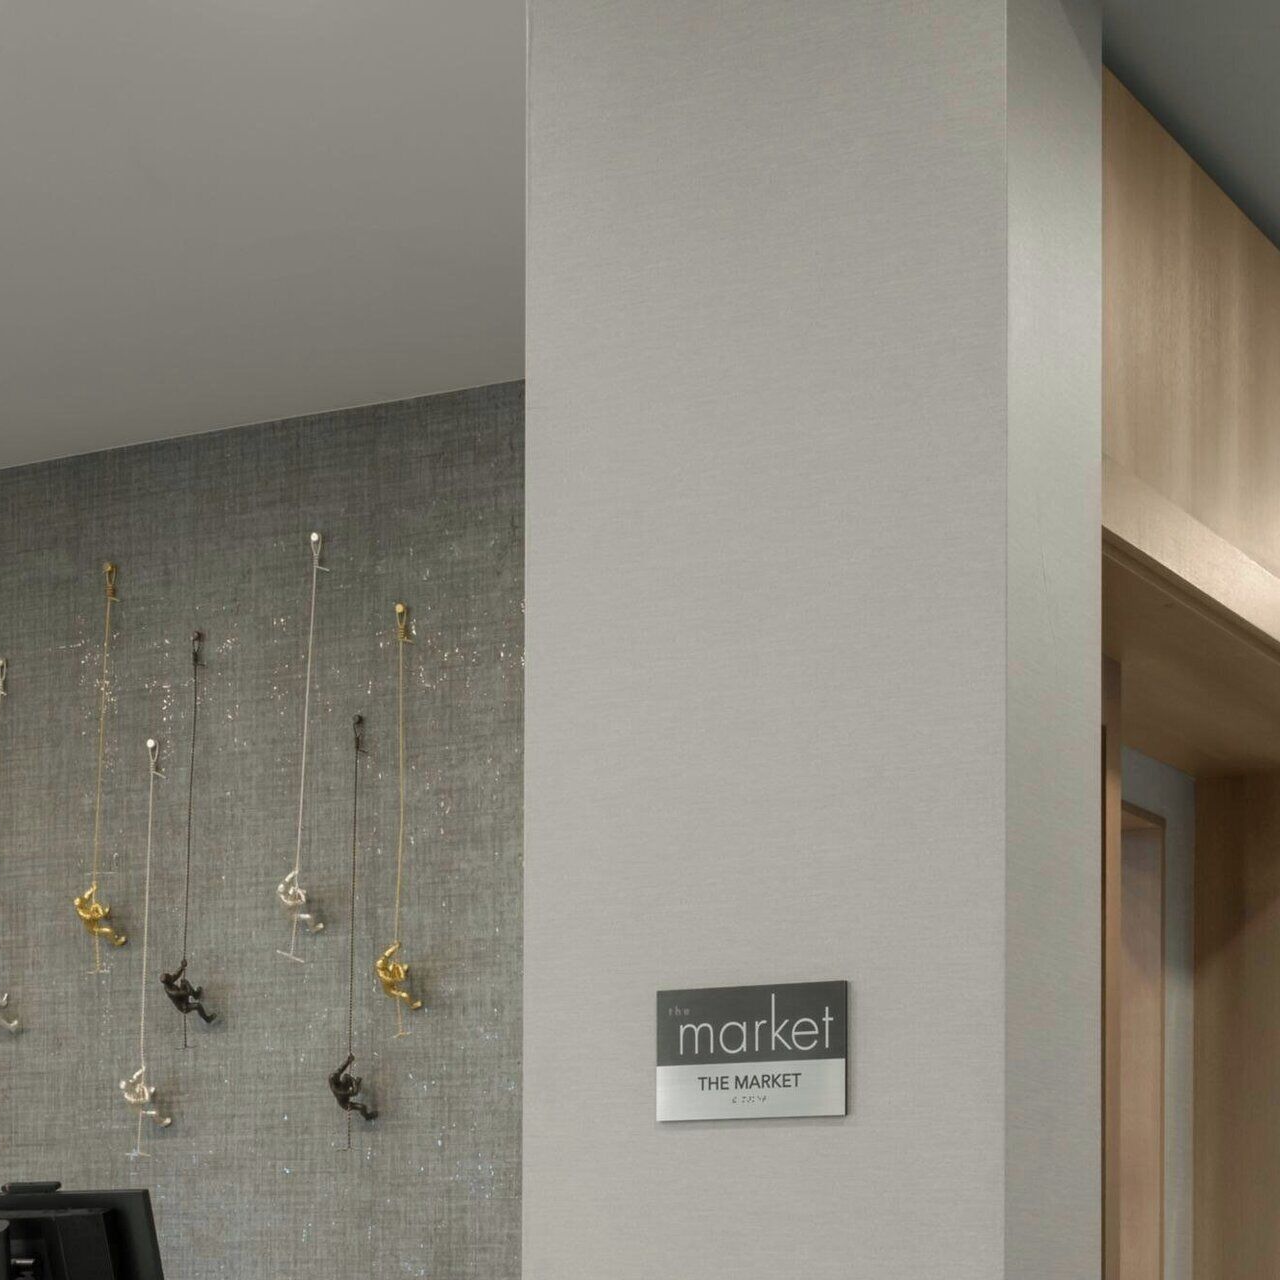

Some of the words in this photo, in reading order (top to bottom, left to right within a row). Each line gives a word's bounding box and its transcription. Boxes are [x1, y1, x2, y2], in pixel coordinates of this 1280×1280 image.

[679, 993, 834, 1055] market
[698, 1076, 729, 1091] THE
[734, 1073, 802, 1090] MARKET
